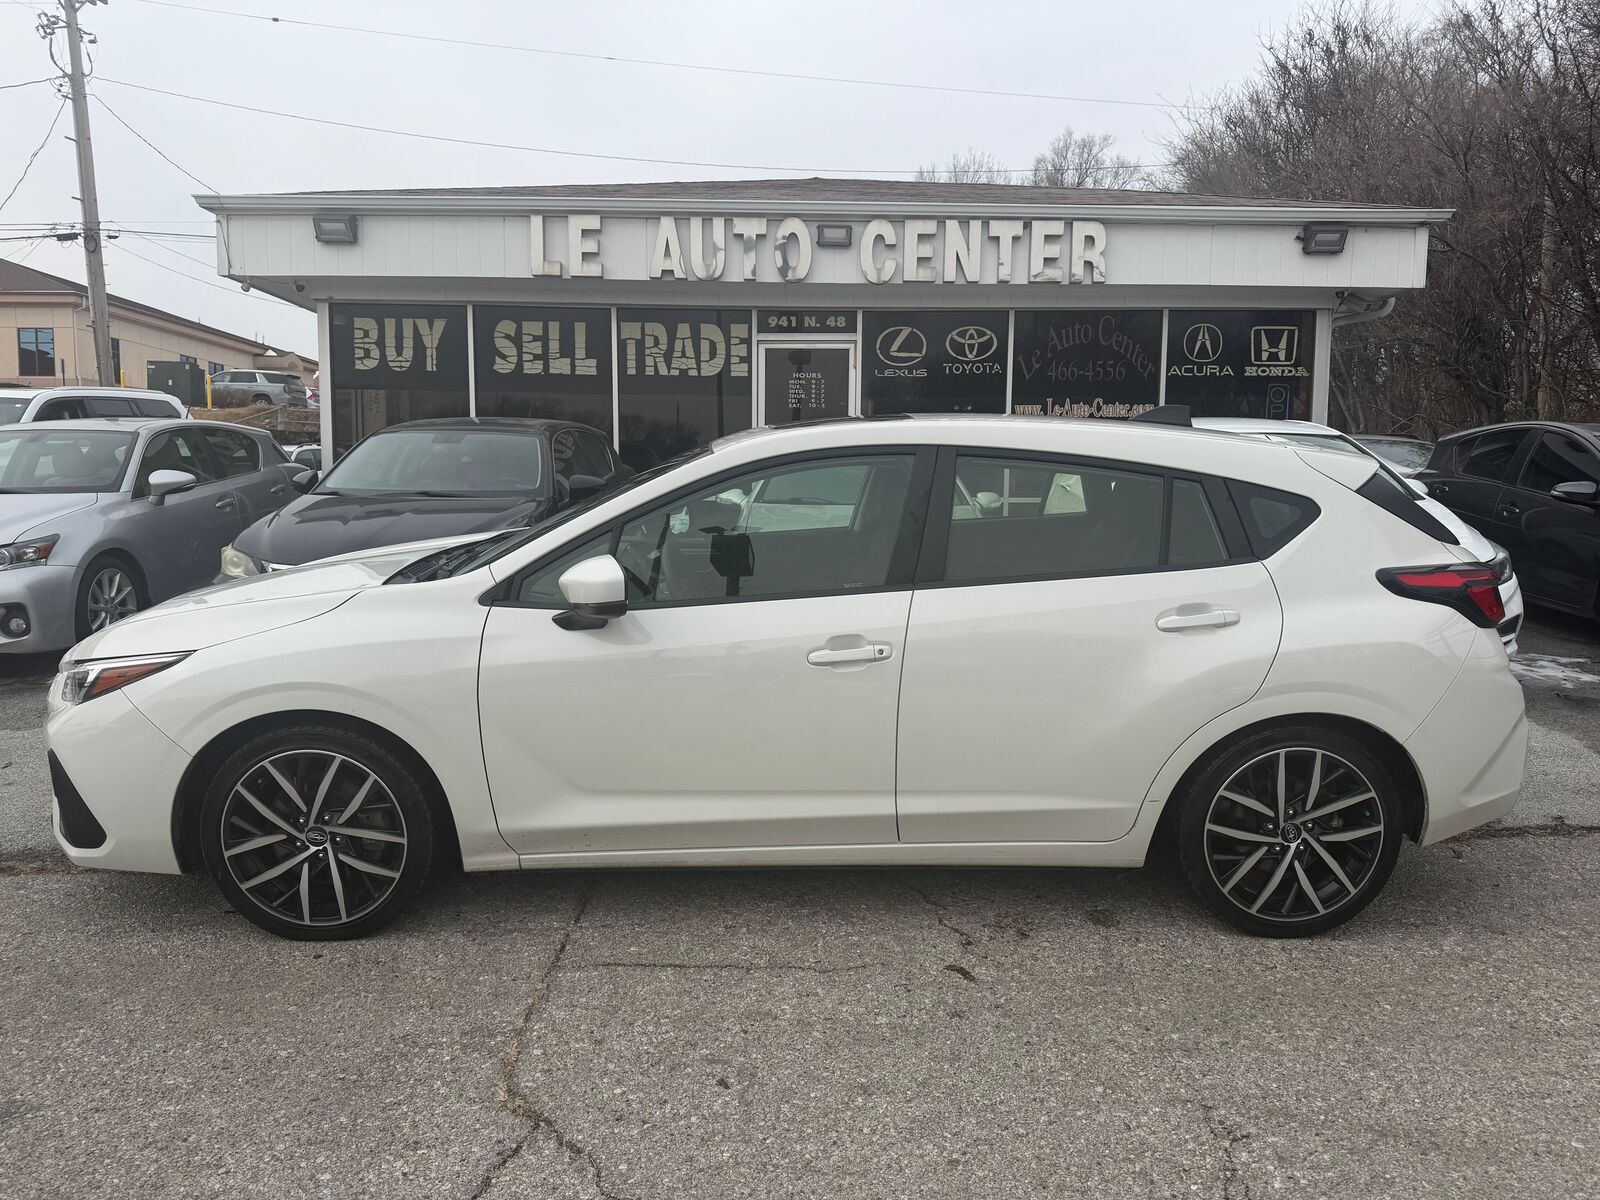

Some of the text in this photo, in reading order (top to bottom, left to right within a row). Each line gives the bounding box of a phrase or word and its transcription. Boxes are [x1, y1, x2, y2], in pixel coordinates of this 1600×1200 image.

[530, 215, 1107, 285] LE AUTO CENTER
[768, 315, 846, 328] 941 N. 48
[353, 317, 447, 371] BUY
[493, 319, 598, 375] SELL
[620, 321, 749, 377] TRADE
[1017, 315, 1155, 381] Le Auto Center
[875, 369, 928, 377] LEXUS
[943, 362, 1002, 374] TOYOTA
[1048, 359, 1126, 382] 466-4556
[1168, 365, 1234, 376] ACURA
[1244, 366, 1310, 376] HONDA
